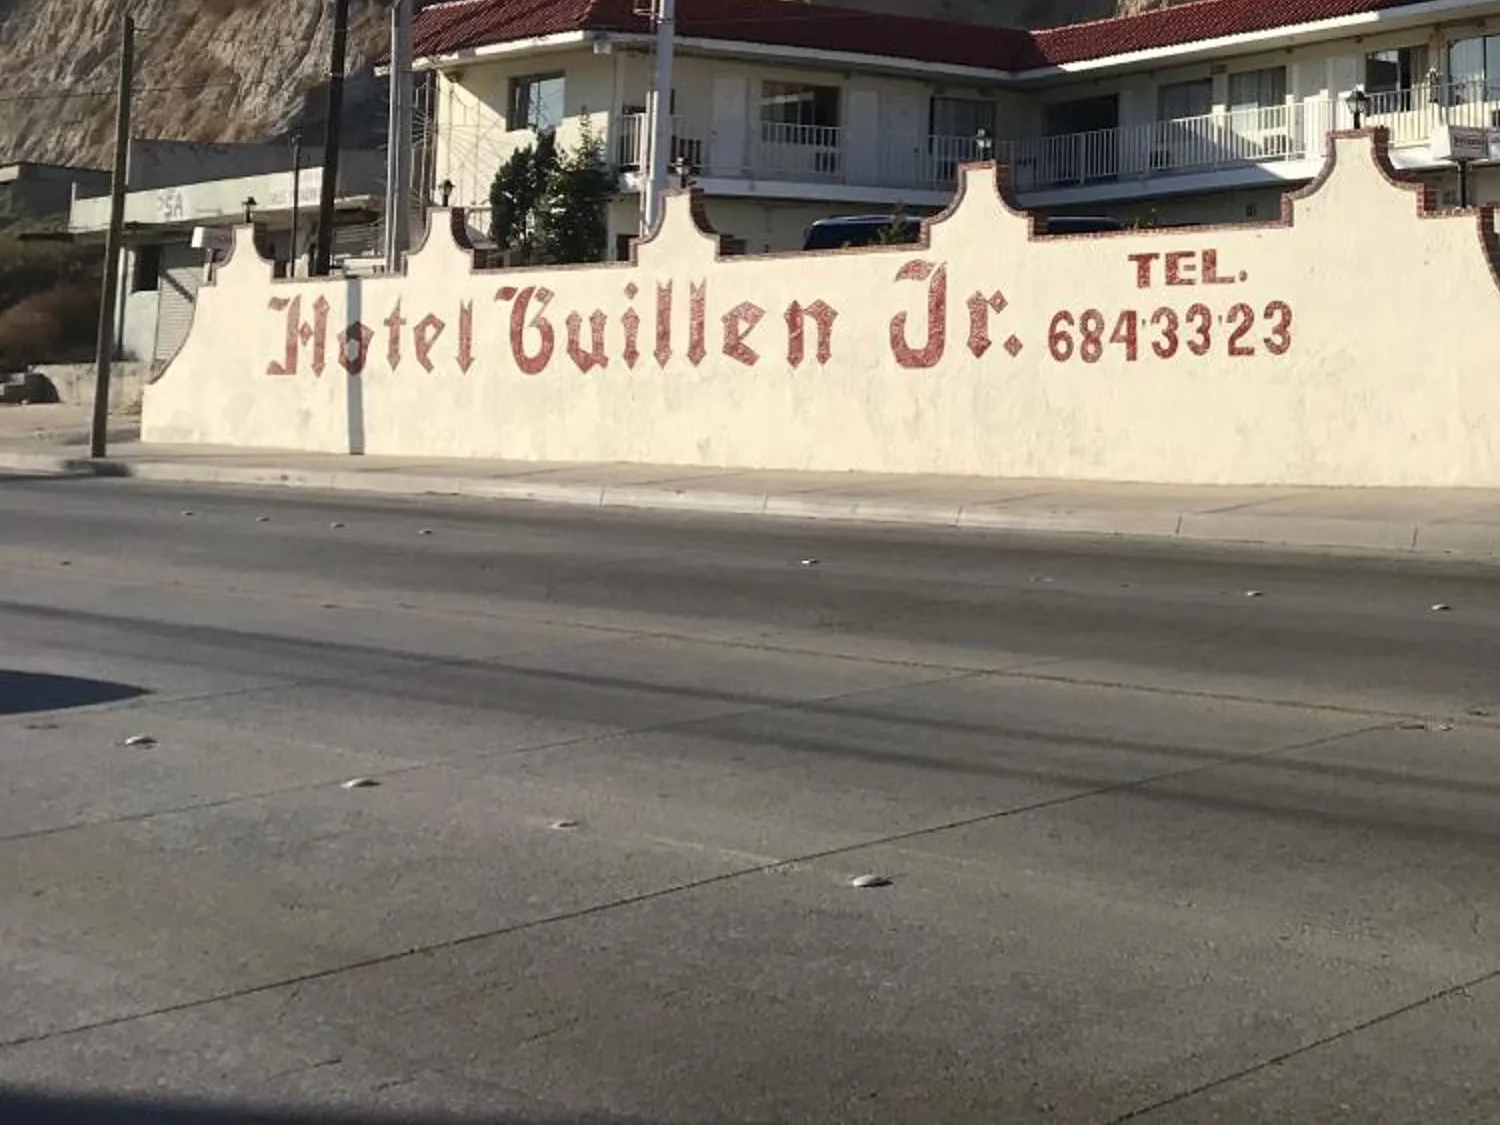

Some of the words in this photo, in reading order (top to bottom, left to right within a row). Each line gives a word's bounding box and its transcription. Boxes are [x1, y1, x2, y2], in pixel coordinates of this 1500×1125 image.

[1127, 248, 1249, 290] TEL.
[265, 293, 477, 379] Hotel
[494, 275, 840, 376] Guillen
[888, 258, 1024, 370] Jr.
